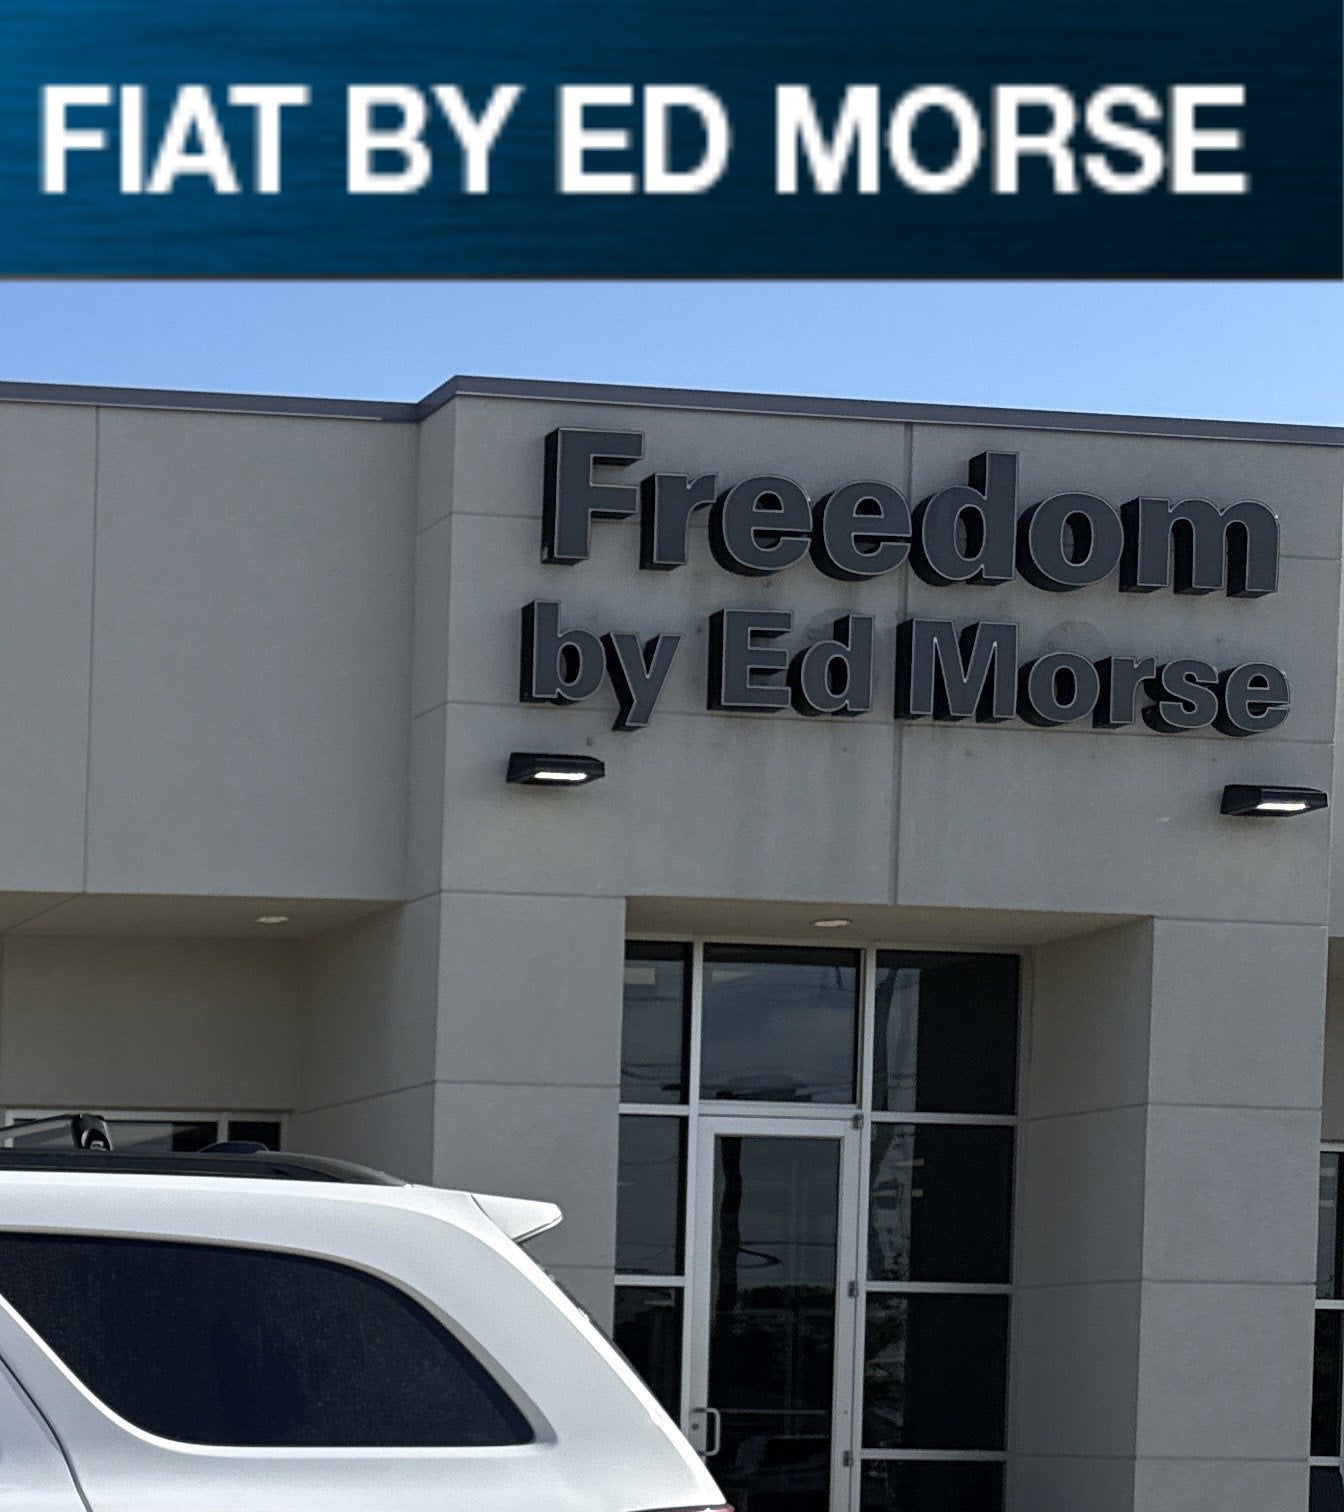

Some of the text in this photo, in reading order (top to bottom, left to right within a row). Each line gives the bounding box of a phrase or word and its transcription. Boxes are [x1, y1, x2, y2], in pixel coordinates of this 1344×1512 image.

[542, 427, 1281, 597] Freedom
[520, 602, 1291, 736] by Ed Morse
